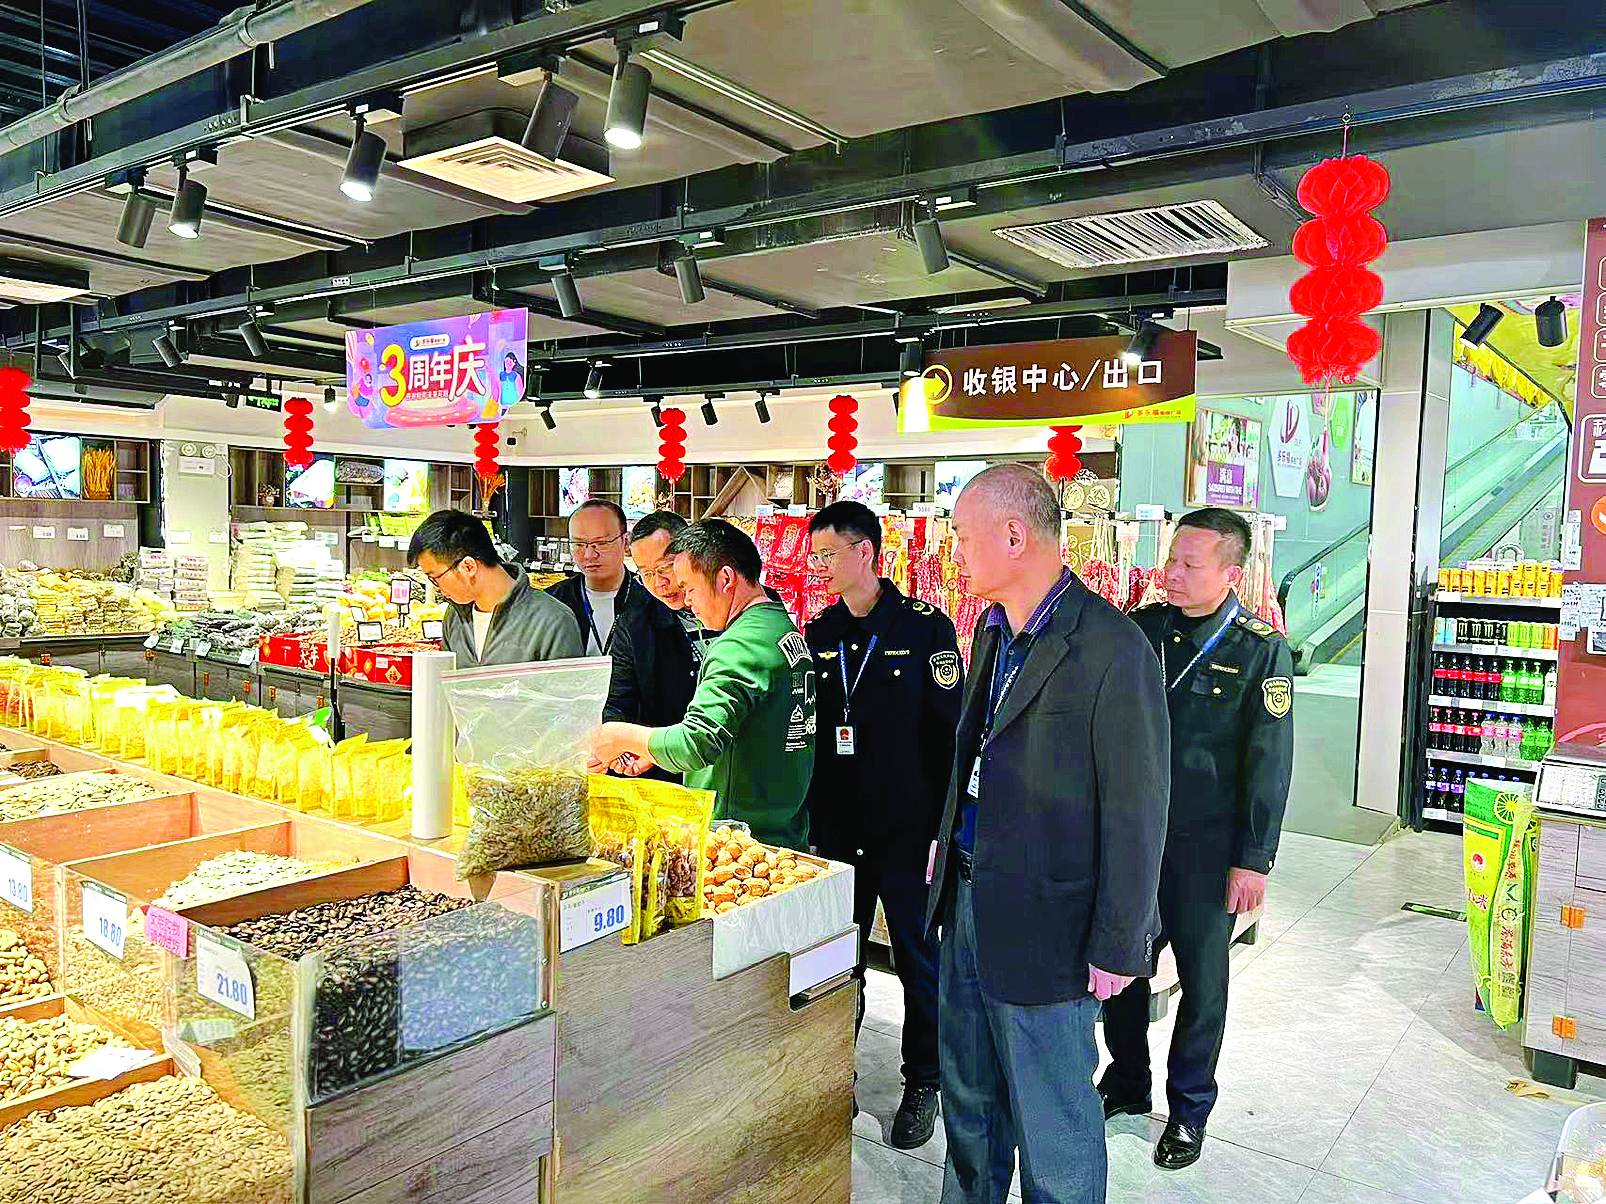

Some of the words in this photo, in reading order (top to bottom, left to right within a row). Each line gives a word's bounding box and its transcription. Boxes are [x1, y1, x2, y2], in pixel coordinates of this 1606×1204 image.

[380, 334, 487, 407] 3周年庆
[962, 358, 1162, 396] 收银中心/出口
[8, 878, 28, 902] 13.80
[99, 916, 122, 947] 18.80
[594, 904, 624, 932] 9.80
[216, 972, 248, 1006] 21.80
